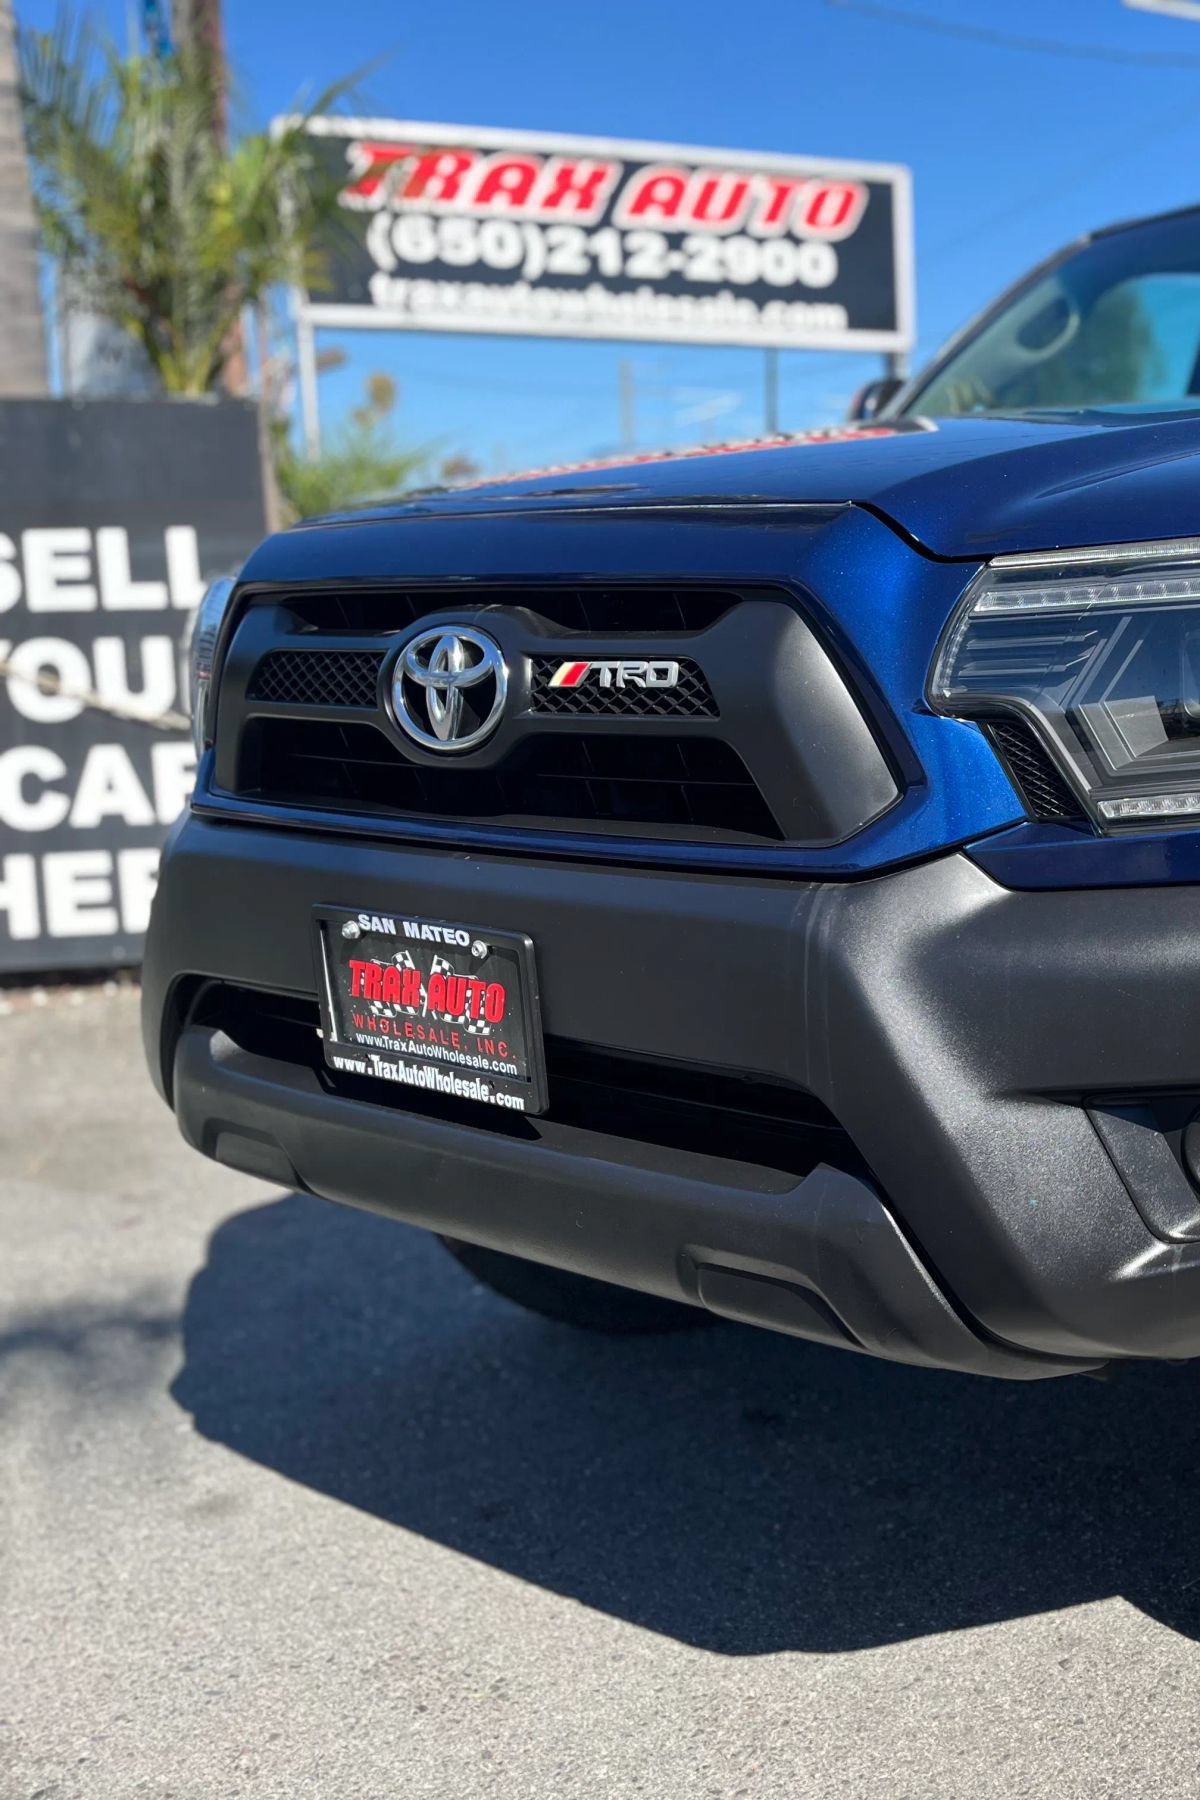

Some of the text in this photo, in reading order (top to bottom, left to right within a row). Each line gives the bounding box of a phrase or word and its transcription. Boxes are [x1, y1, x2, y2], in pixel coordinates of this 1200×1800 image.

[340, 141, 868, 241] TRAX AUTO
[366, 213, 838, 288] (650)212-2900
[358, 914, 470, 947] SAN MATEO
[349, 960, 507, 1024] TRAX AUTO
[355, 1032, 518, 1076] www.TraxAutoWholesale.com
[477, 1037, 517, 1059] INC.
[333, 1054, 525, 1111] www.TraxAutoWholesale.com
